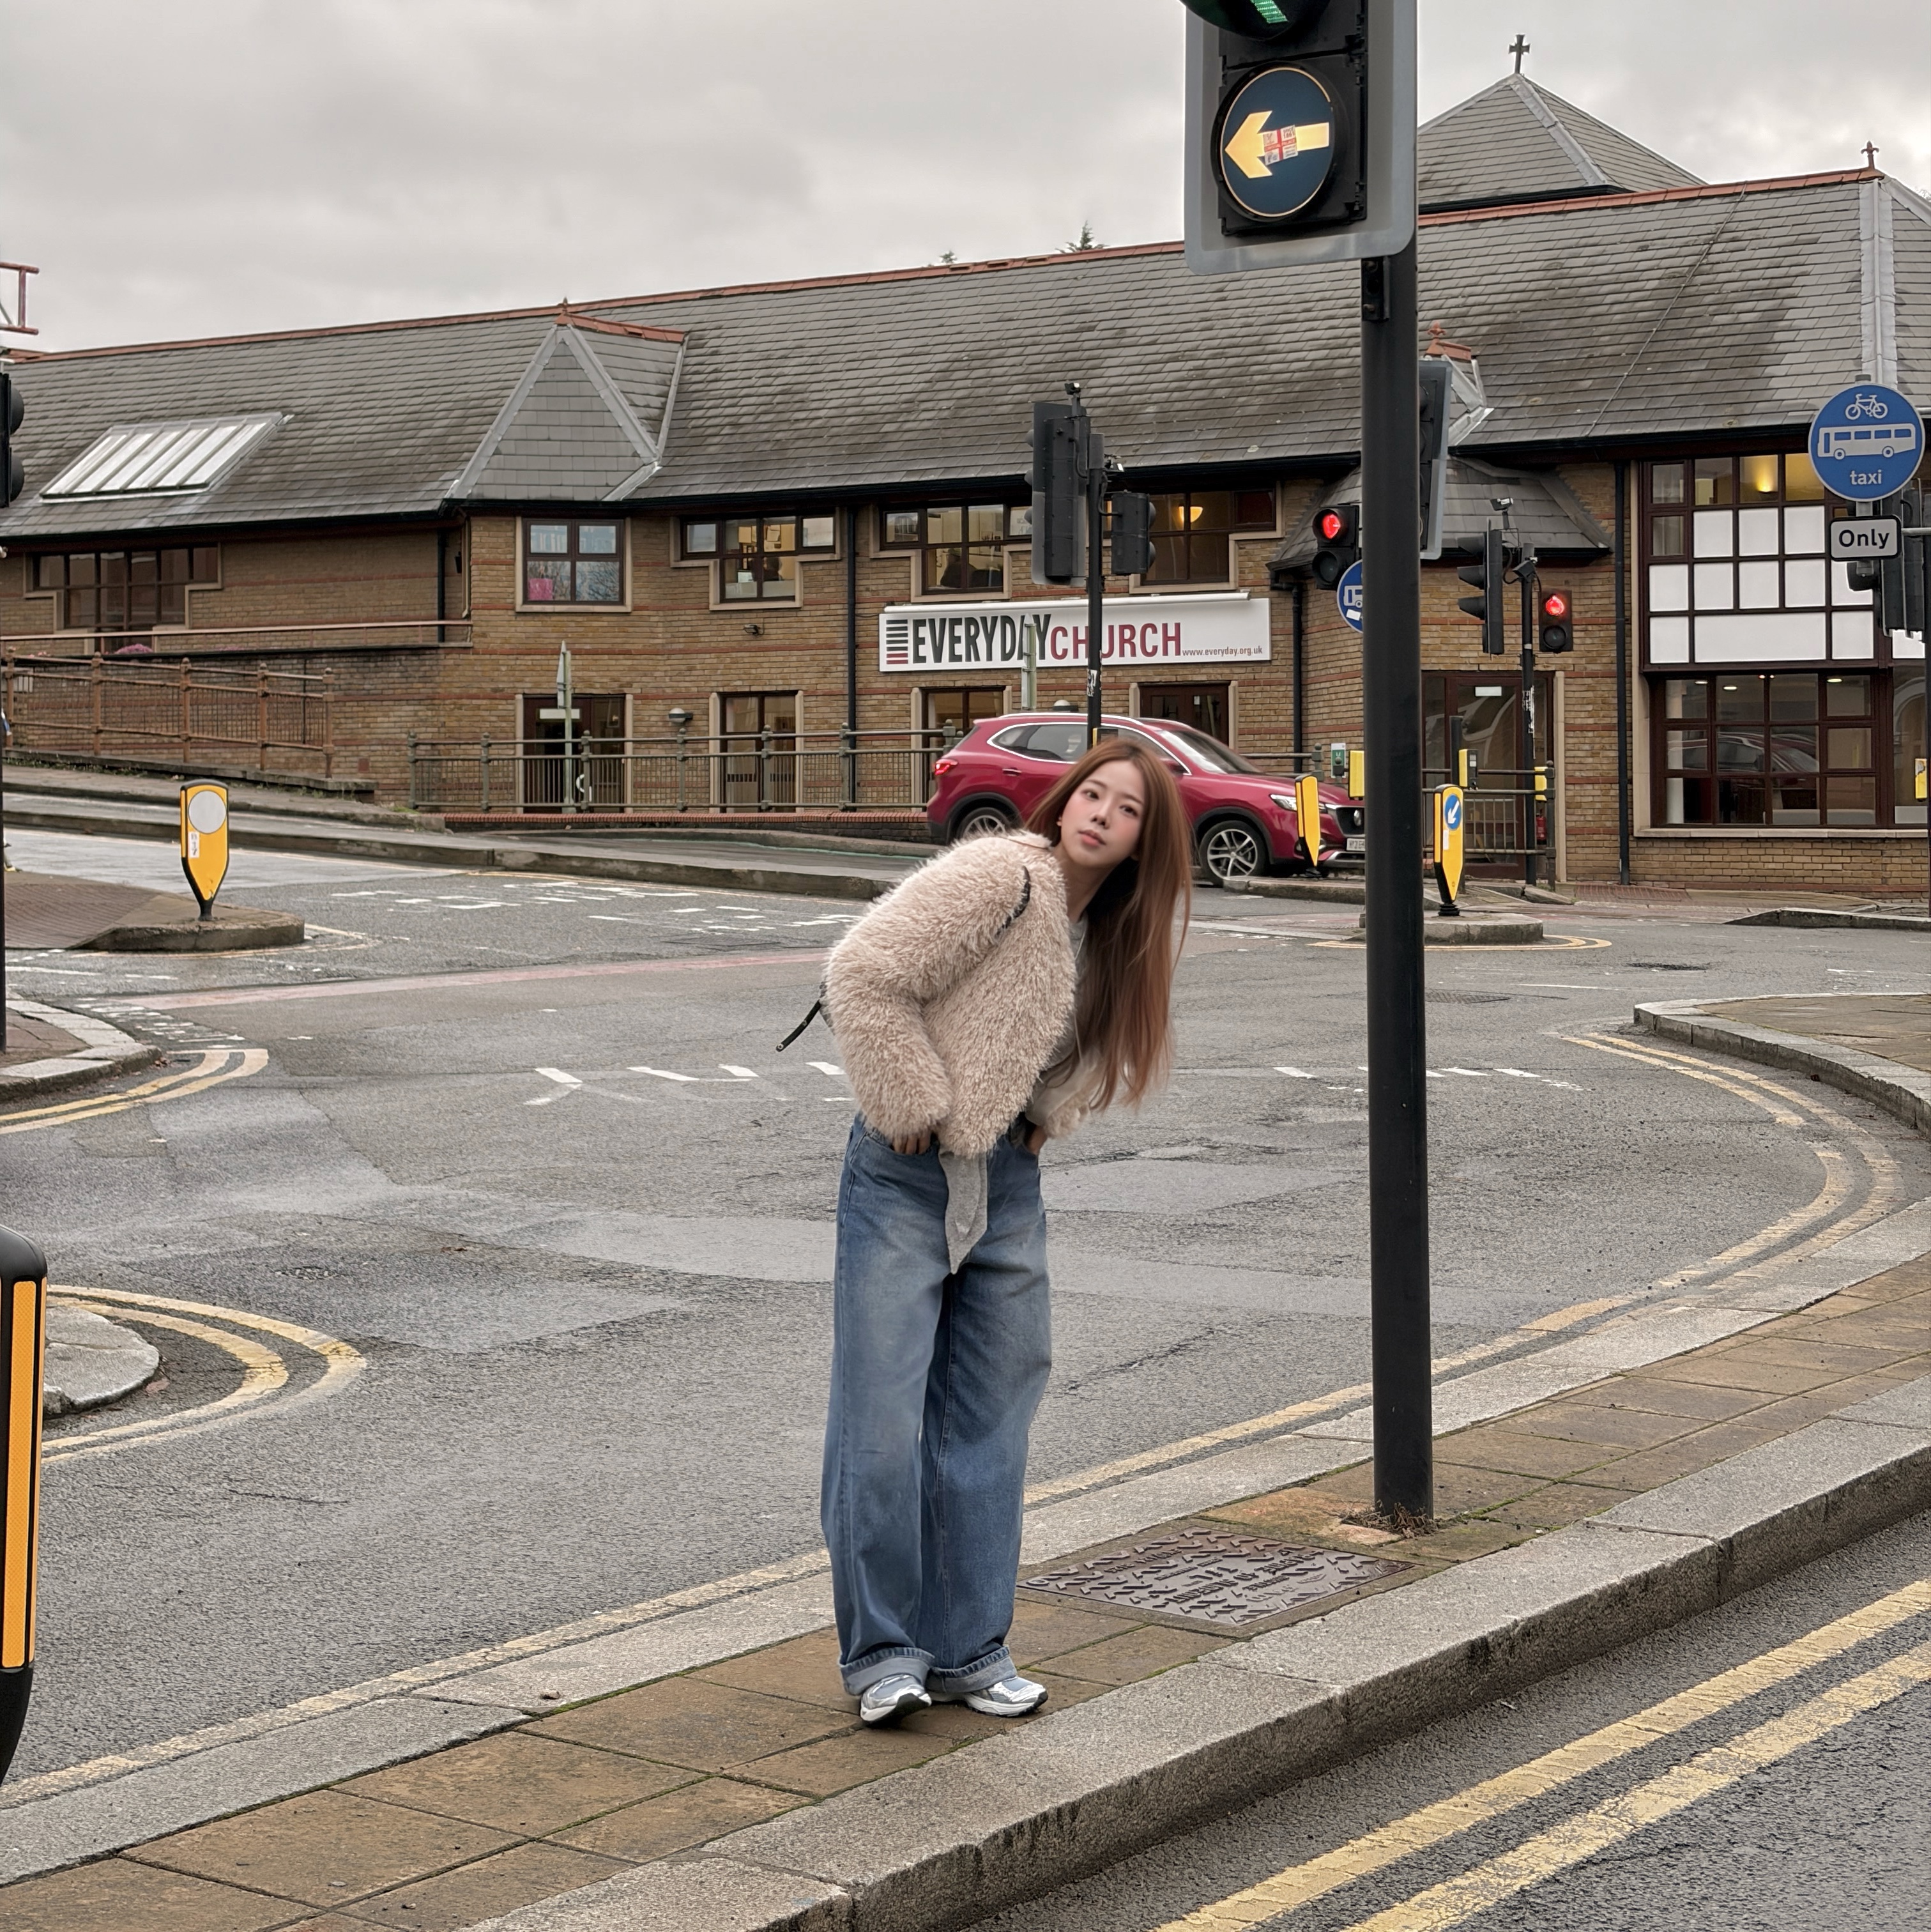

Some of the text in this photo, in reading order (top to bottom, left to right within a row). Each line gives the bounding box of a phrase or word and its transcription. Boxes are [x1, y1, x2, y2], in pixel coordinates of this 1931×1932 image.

[1850, 469, 1882, 485] taxi
[1838, 528, 1889, 549] Only
[1182, 645, 1263, 657] www.everyday.org.uk
